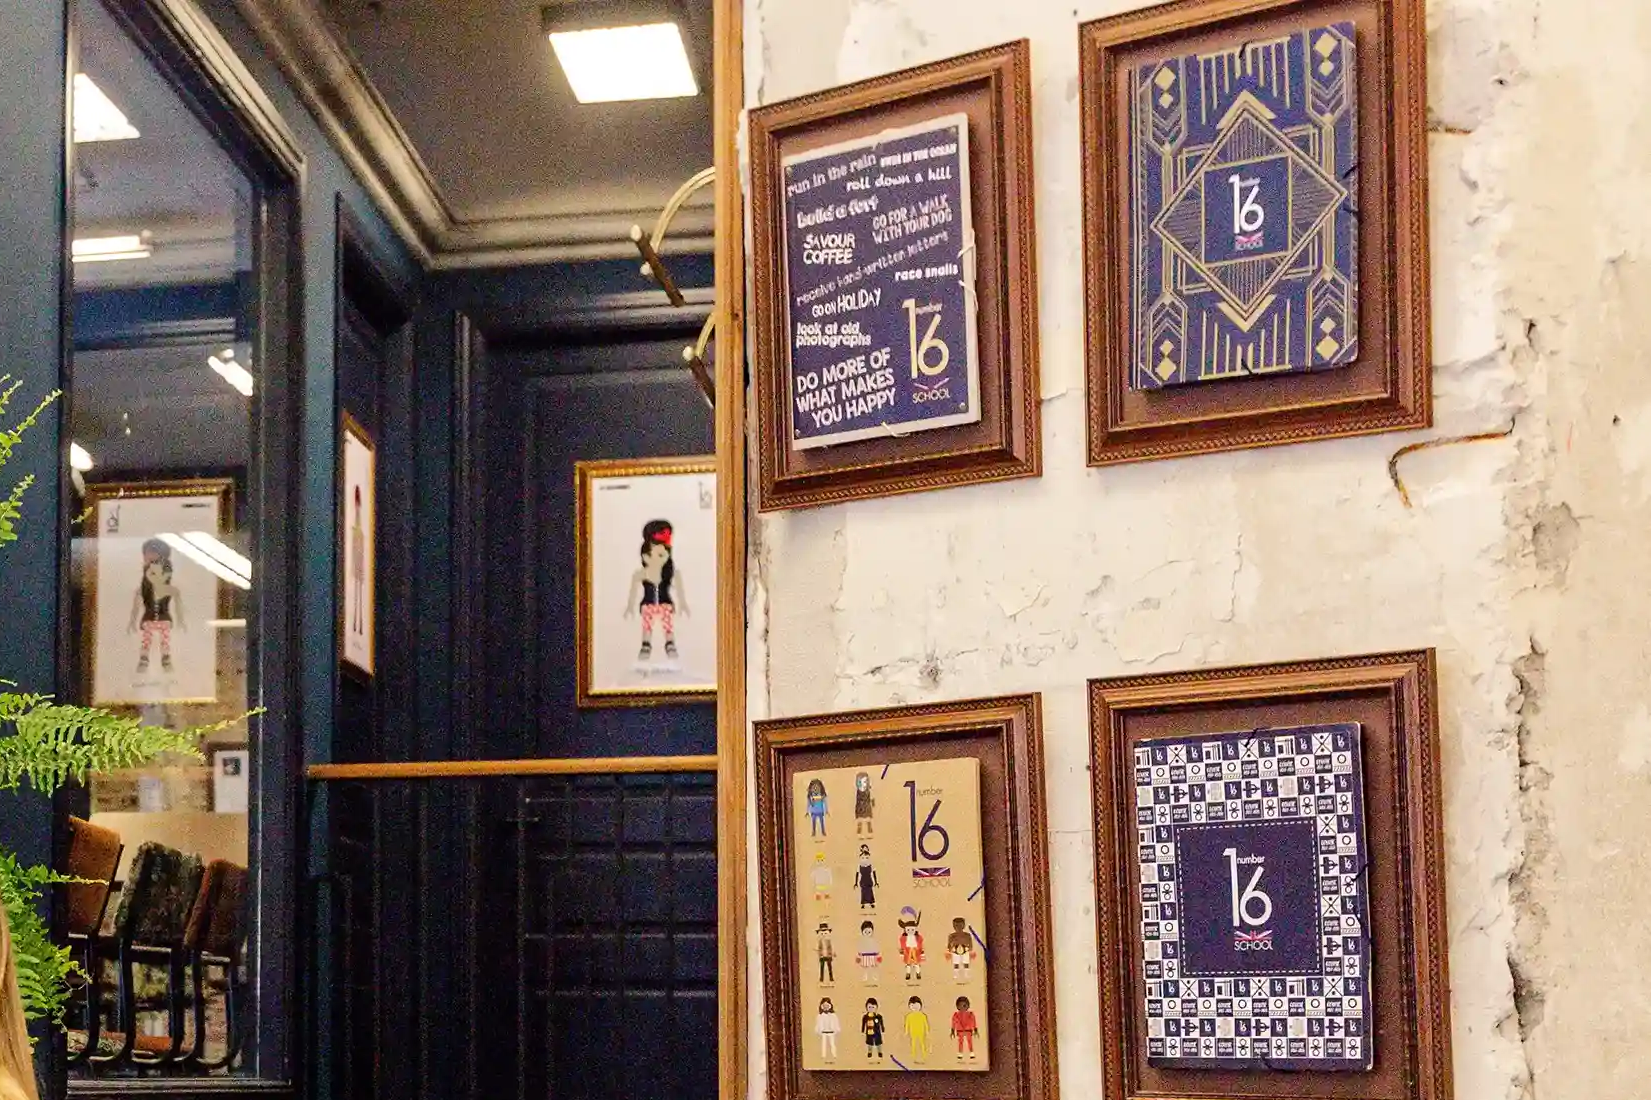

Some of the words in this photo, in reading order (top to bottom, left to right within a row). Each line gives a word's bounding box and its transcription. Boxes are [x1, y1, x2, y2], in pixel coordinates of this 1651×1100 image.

[787, 180, 810, 197] run
[813, 172, 826, 188] in
[828, 165, 848, 180] the
[849, 153, 877, 172] rain
[846, 176, 870, 192] roll
[875, 174, 910, 187] down
[928, 165, 952, 181] hill
[873, 213, 887, 230] GO
[889, 207, 908, 225] FOR
[909, 206, 918, 218] A
[919, 194, 949, 215] WALK
[1229, 173, 1265, 234] 16
[803, 233, 856, 249] SAVOUR
[872, 226, 902, 244] WITH
[904, 215, 930, 234] YOUR
[931, 209, 953, 225] DOG
[803, 249, 853, 265] COFFEE
[894, 268, 923, 282] race
[925, 263, 959, 278] snails
[812, 304, 824, 318] GO
[837, 288, 882, 313] HOLIDAY
[795, 334, 872, 348] photographs
[797, 322, 822, 335] look
[824, 323, 839, 335] at
[840, 322, 860, 335] old
[902, 298, 950, 379] 16
[797, 372, 819, 393] DO
[822, 355, 866, 385] MORE
[870, 347, 891, 369] OF
[795, 385, 837, 413] WHAT
[841, 368, 895, 400] MAKES
[912, 388, 951, 404] SCHOOL
[811, 408, 843, 428] YOU
[846, 387, 896, 419] HAPPY
[903, 780, 949, 862] 16
[913, 879, 952, 889] SCHOOL
[1223, 848, 1272, 927] 16
[1234, 940, 1273, 951] SCHOOL
